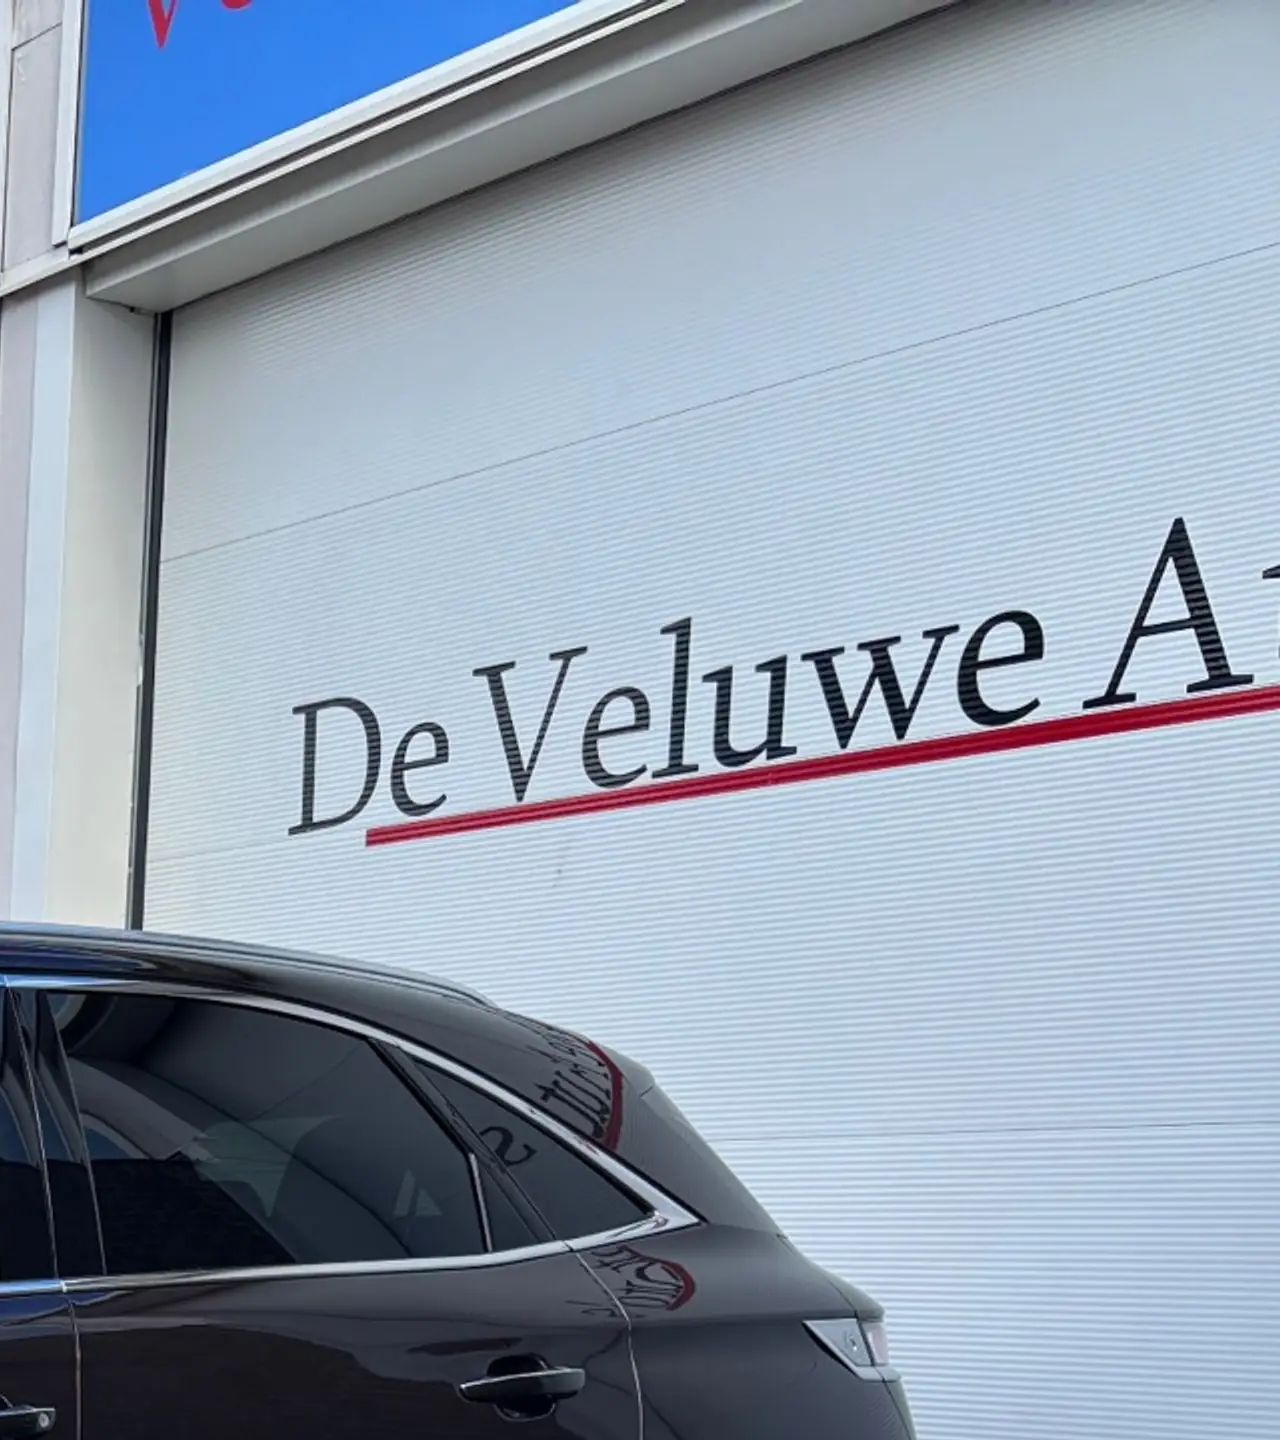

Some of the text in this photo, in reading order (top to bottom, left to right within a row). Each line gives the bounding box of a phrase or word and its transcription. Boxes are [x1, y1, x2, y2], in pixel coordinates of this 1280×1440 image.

[287, 516, 1280, 836] De Veluwe A
